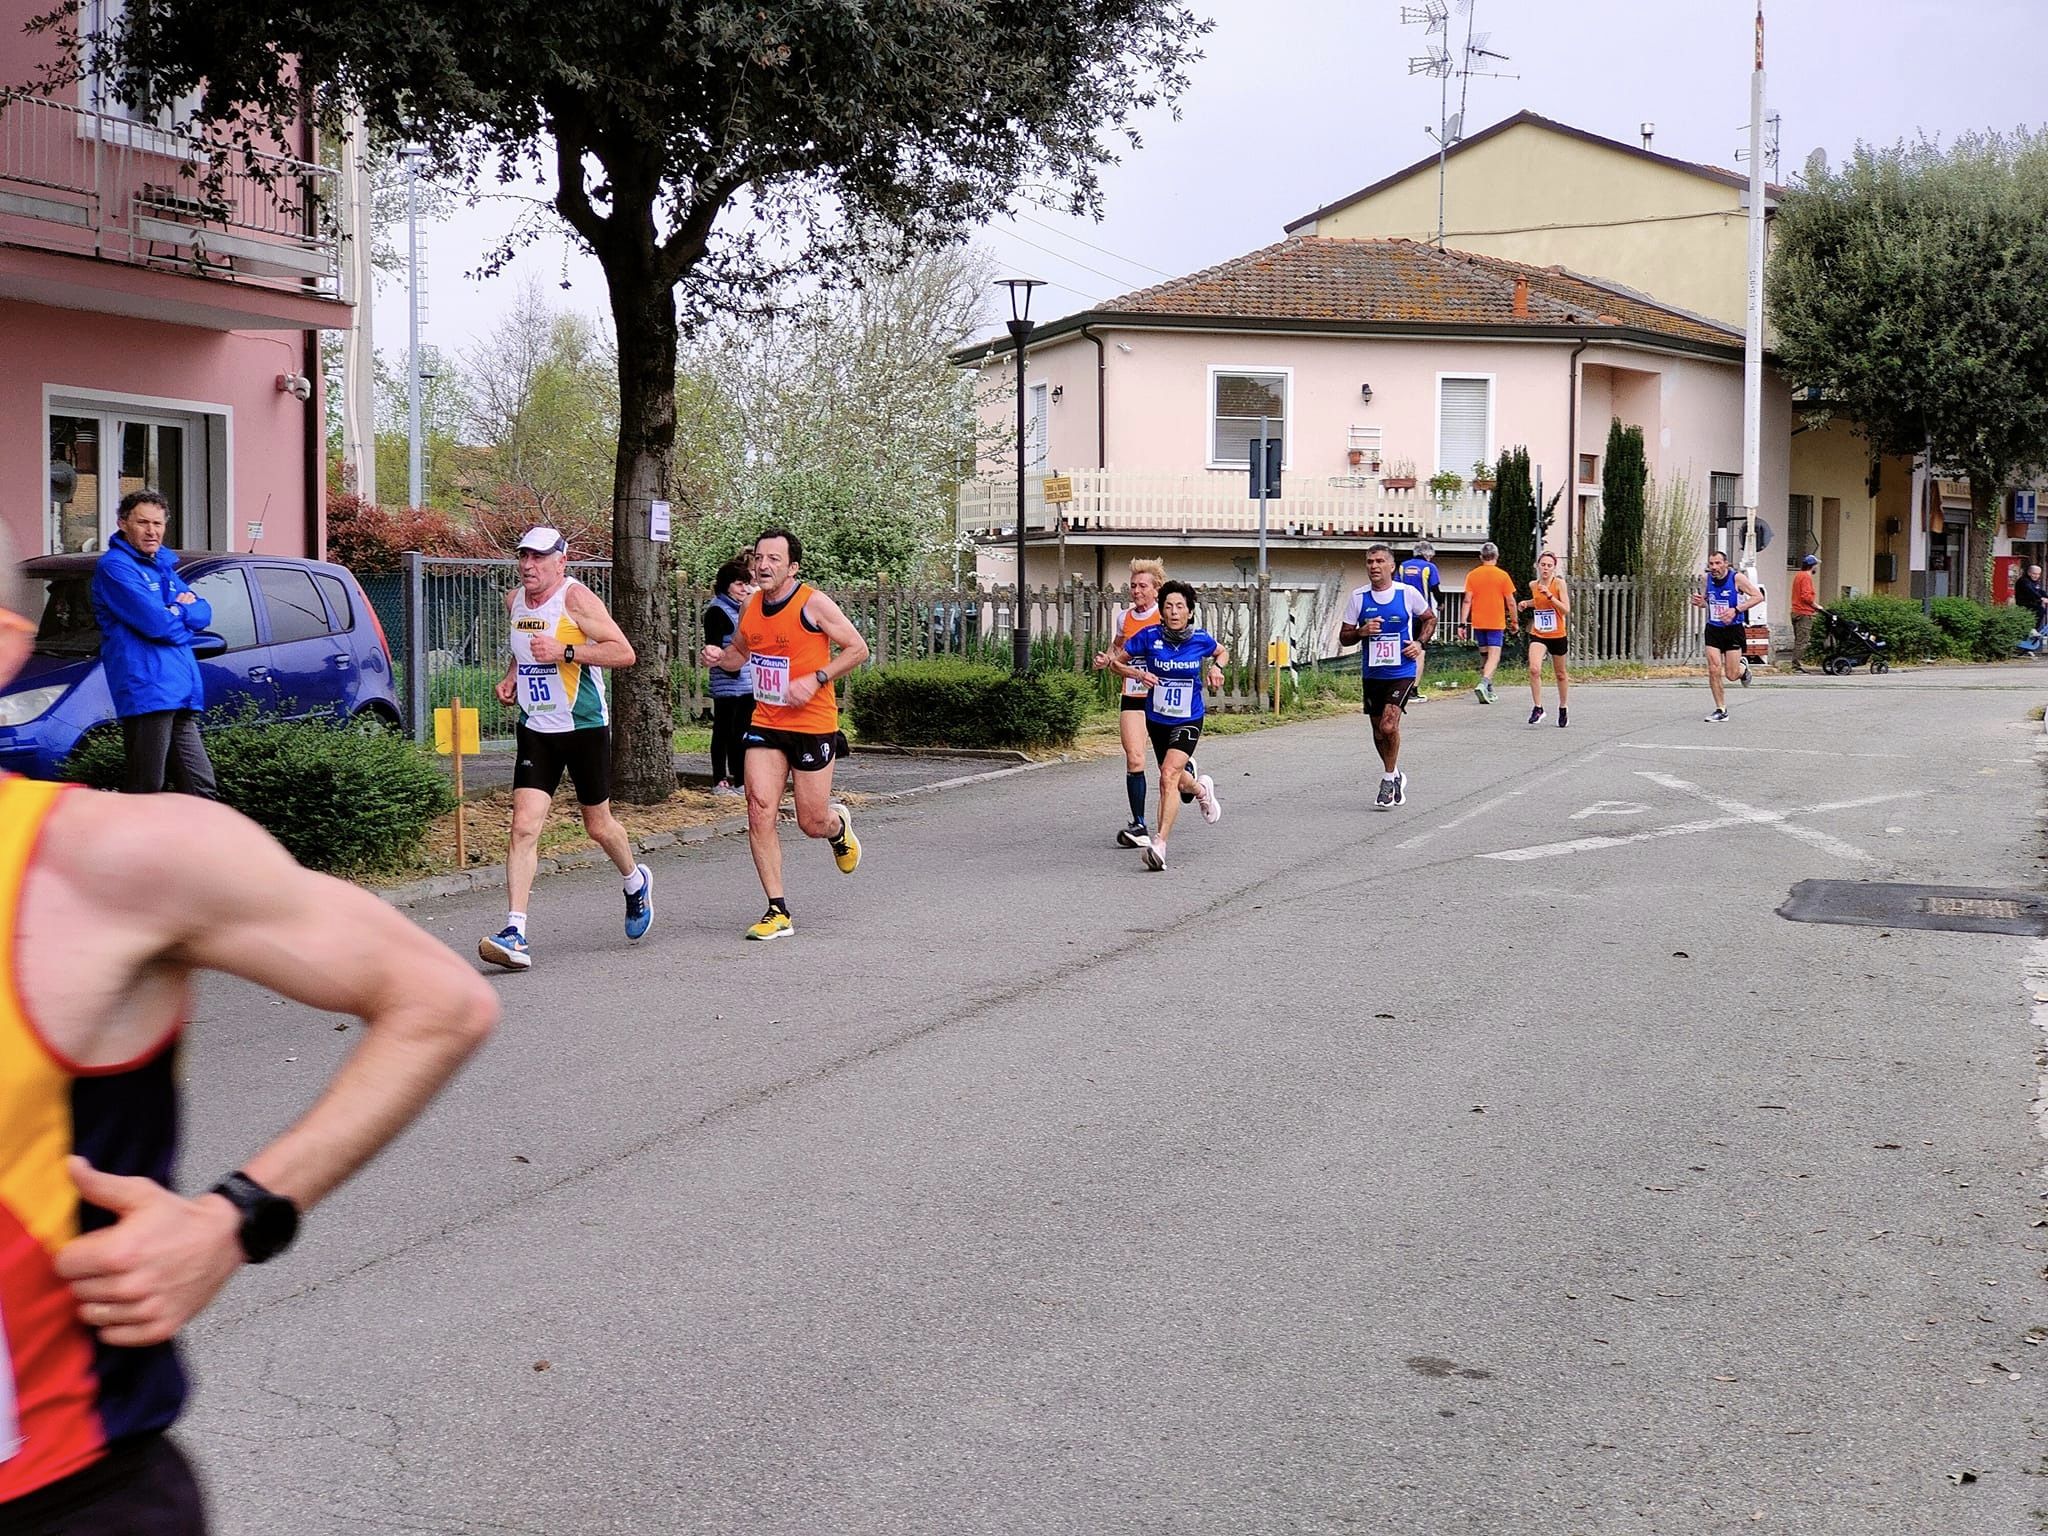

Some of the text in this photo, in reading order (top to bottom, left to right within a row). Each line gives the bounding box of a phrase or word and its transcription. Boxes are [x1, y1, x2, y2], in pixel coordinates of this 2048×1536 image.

[517, 621, 545, 630] MAMELI
[1540, 615, 1552, 627] 151
[1376, 642, 1395, 658] 251
[755, 666, 781, 692] 264
[528, 676, 551, 702] 55
[1164, 688, 1182, 707] 49
